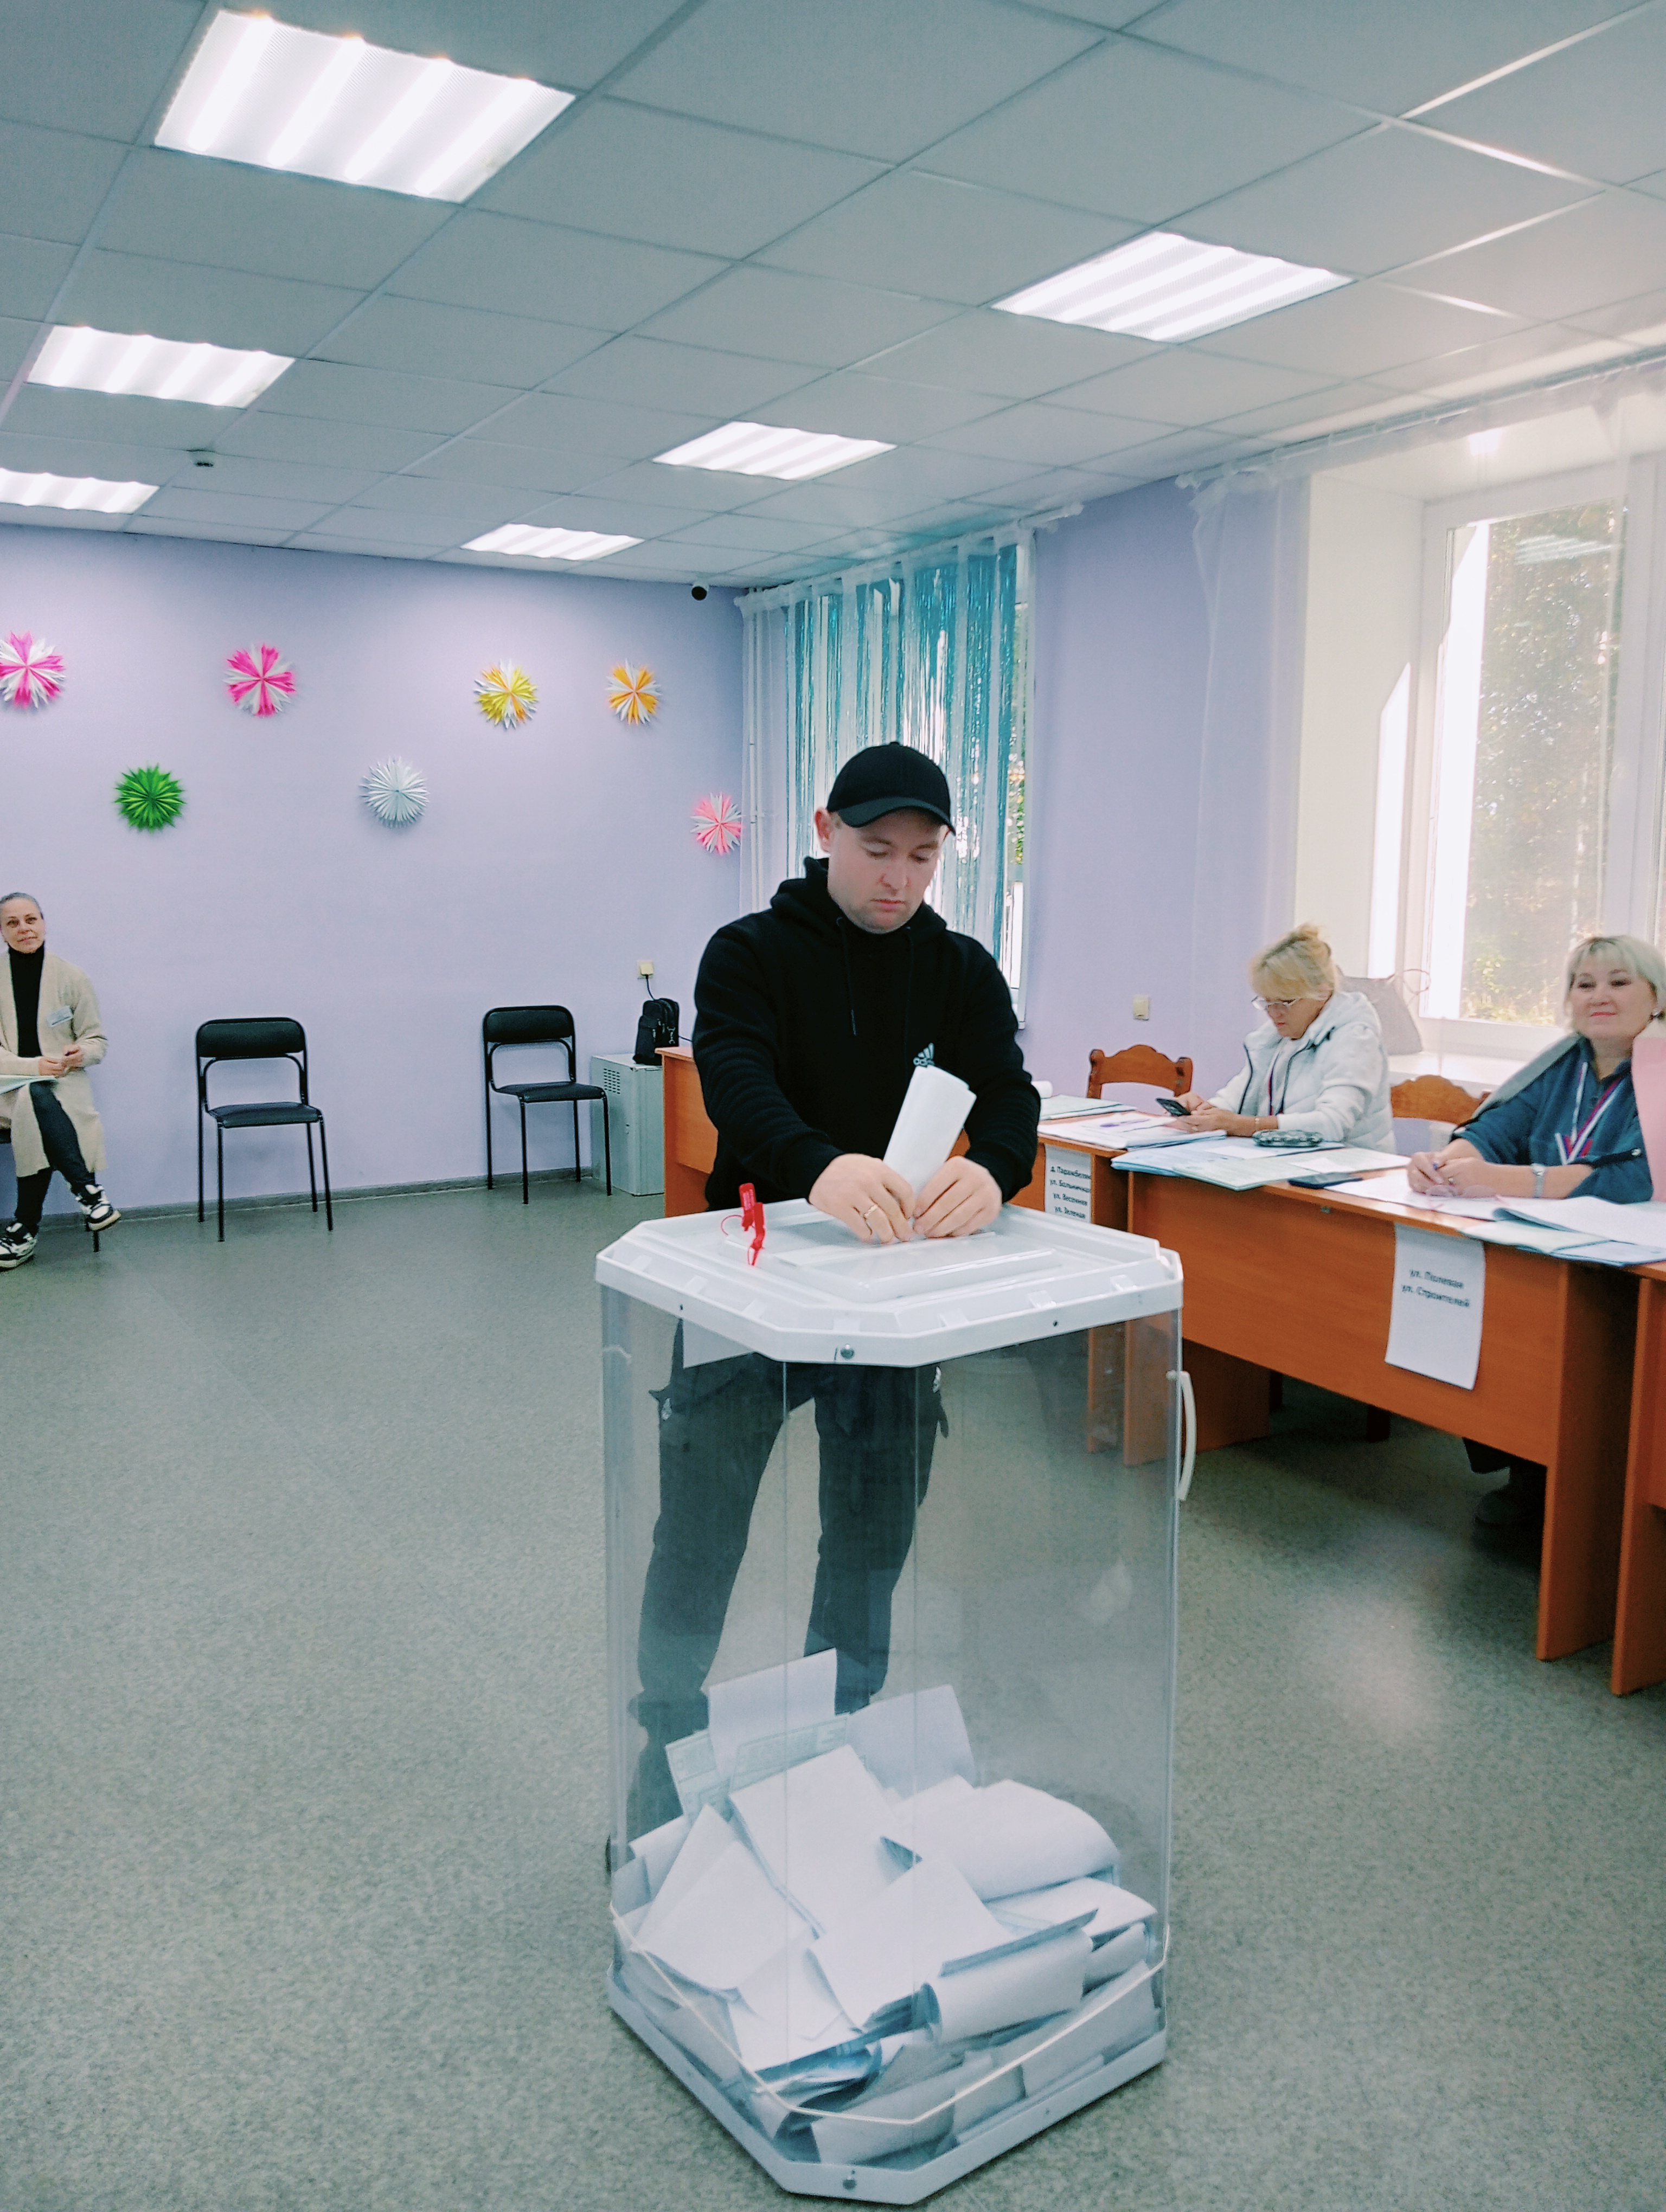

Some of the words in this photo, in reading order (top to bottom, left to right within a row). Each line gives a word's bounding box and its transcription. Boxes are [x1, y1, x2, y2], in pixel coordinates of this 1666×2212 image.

[1410, 1269, 1421, 1278] ул.
[1424, 1271, 1464, 1289] Полевая
[1402, 1284, 1413, 1293] ул.
[1416, 1286, 1470, 1307] Строителей
